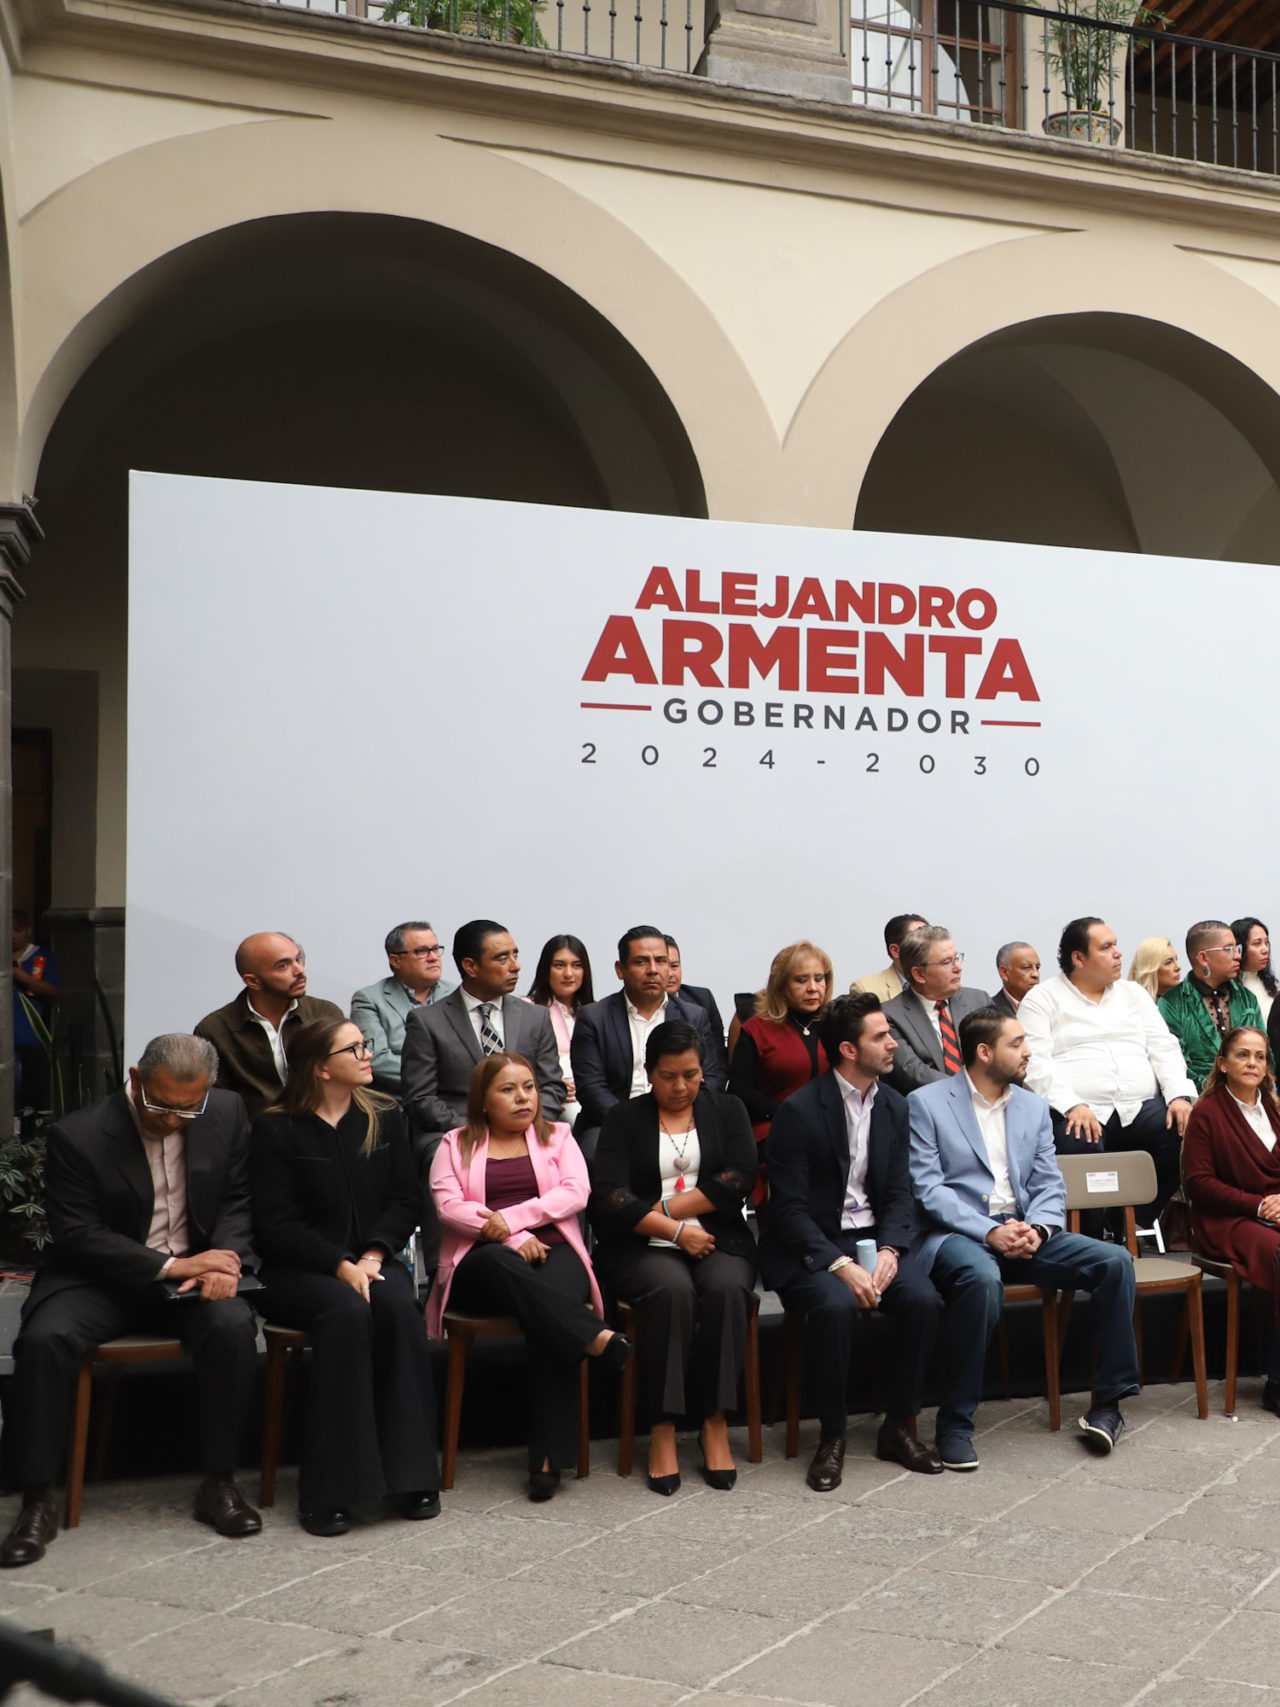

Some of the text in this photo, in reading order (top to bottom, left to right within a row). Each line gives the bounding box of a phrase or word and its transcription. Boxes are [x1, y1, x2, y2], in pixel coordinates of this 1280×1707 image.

[635, 565, 998, 631] ALEJANDRO
[581, 614, 1041, 702] ARMENTA
[663, 697, 970, 735] GOBERNADOR
